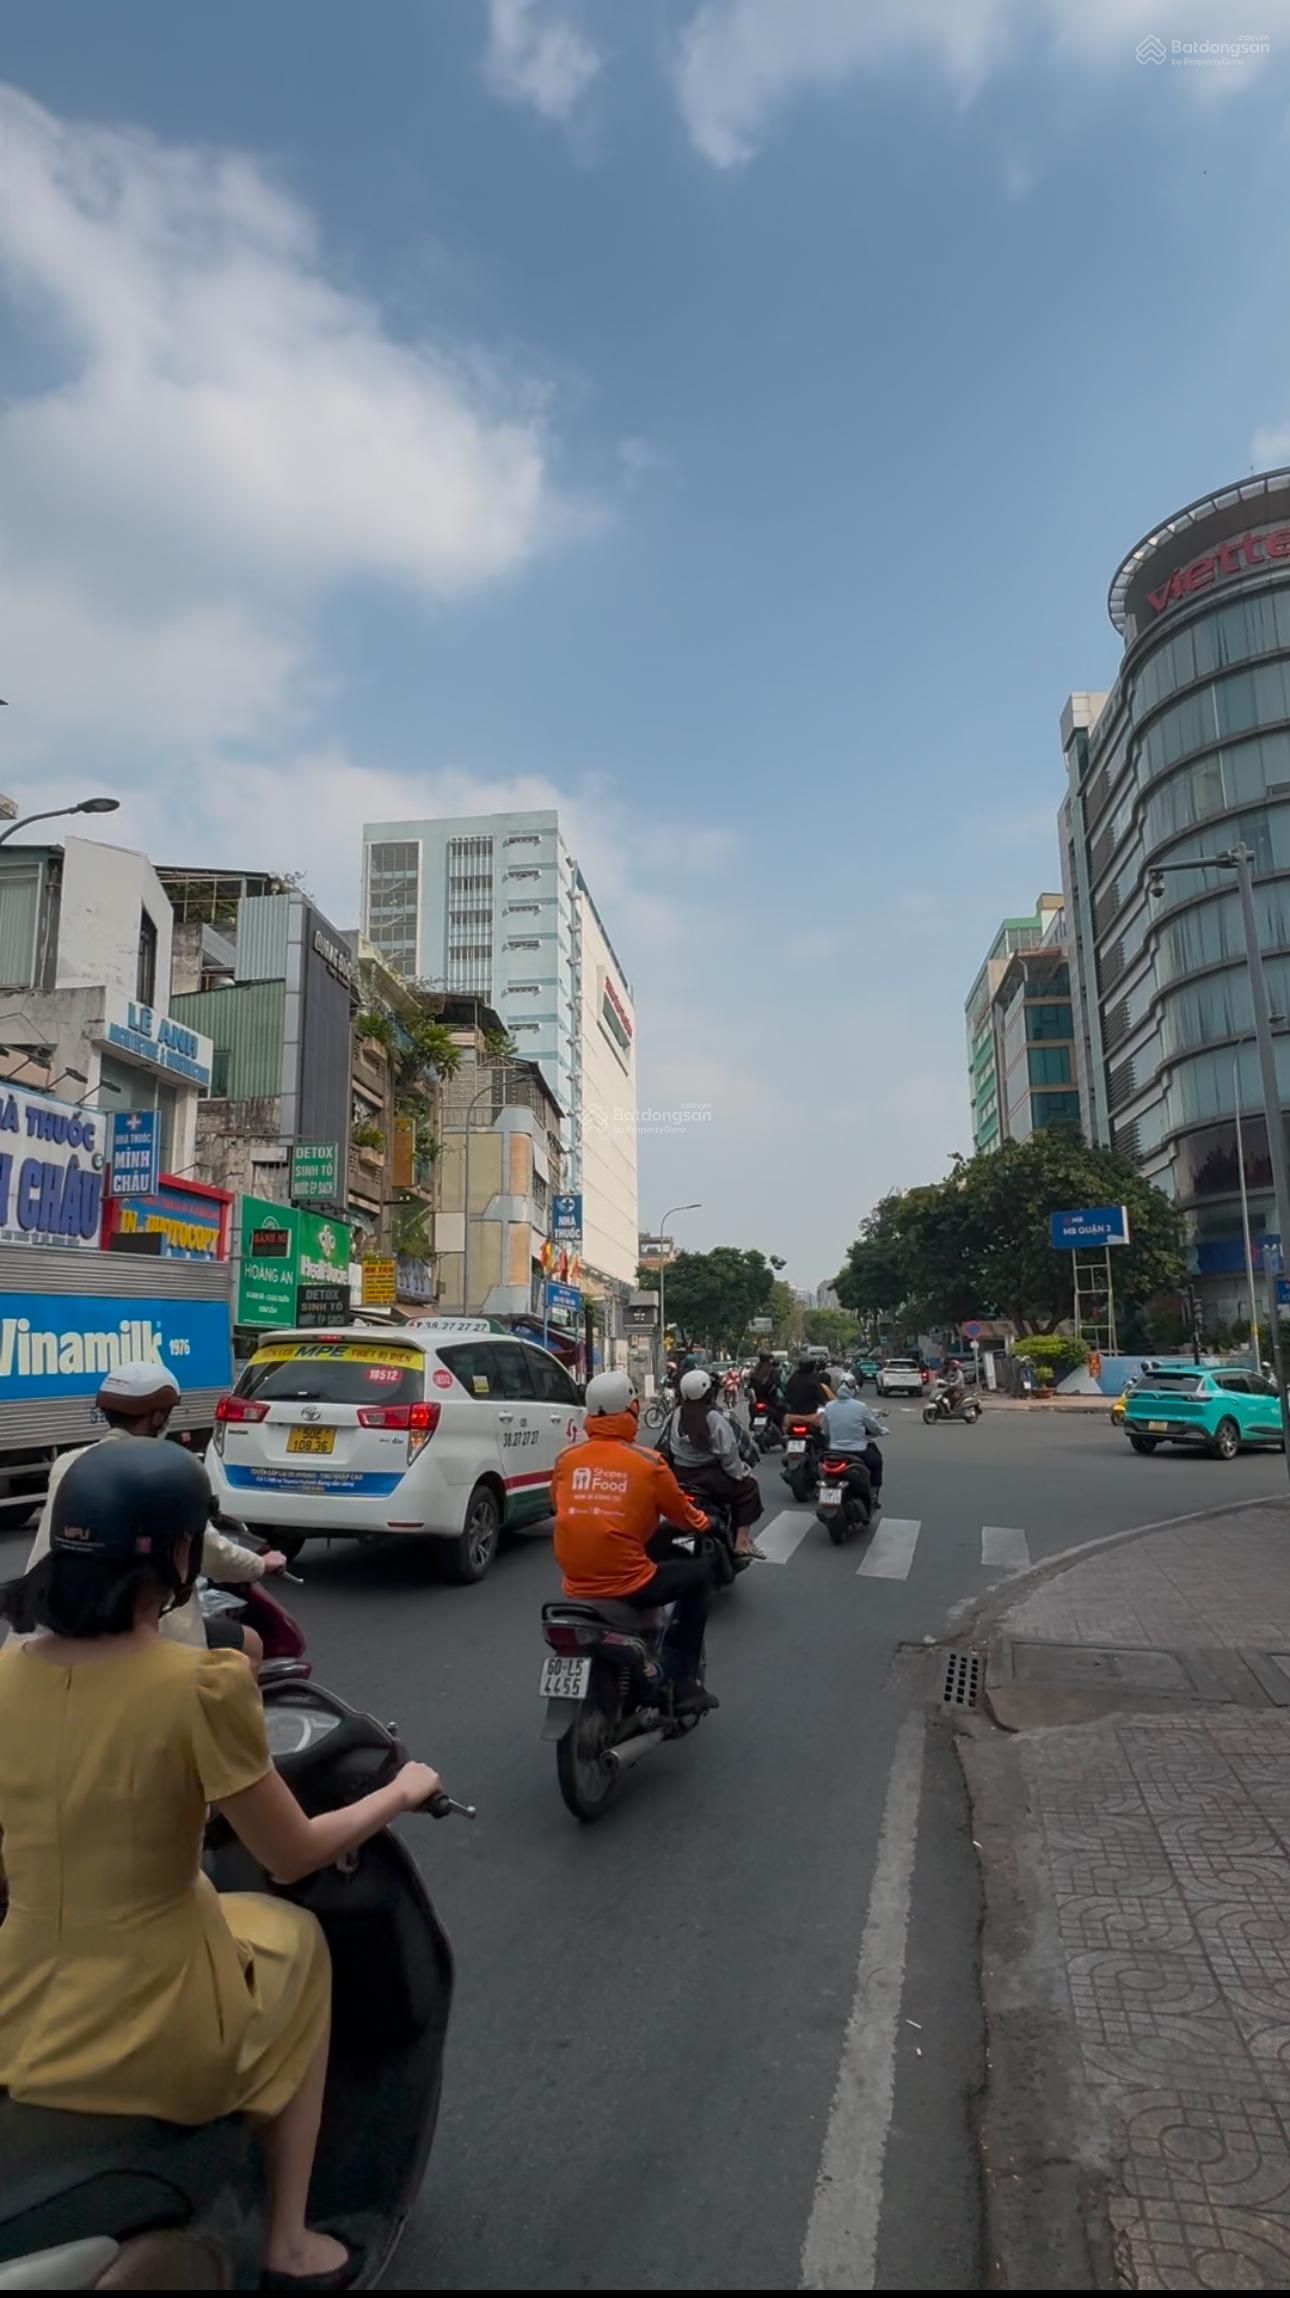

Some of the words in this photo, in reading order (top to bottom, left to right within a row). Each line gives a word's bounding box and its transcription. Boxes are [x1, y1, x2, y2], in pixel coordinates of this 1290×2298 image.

[296, 1146, 333, 1159] DETOX
[295, 1166, 318, 1176] SINH
[18, 1154, 102, 1240] CHÂU
[558, 1214, 576, 1225] NHÀ
[554, 1226, 581, 1239] THUỐC
[1063, 1227, 1077, 1235] MB
[1078, 1224, 1104, 1235] QUẬN
[244, 1261, 279, 1283] HOÀNG
[280, 1270, 293, 1285] AN
[306, 1289, 340, 1300] DETOX
[301, 1302, 326, 1312] SINH
[169, 1339, 190, 1355] 1976
[294, 1345, 349, 1358] MPE
[592, 1477, 627, 1492] Food
[544, 1677, 581, 1696] 4455
